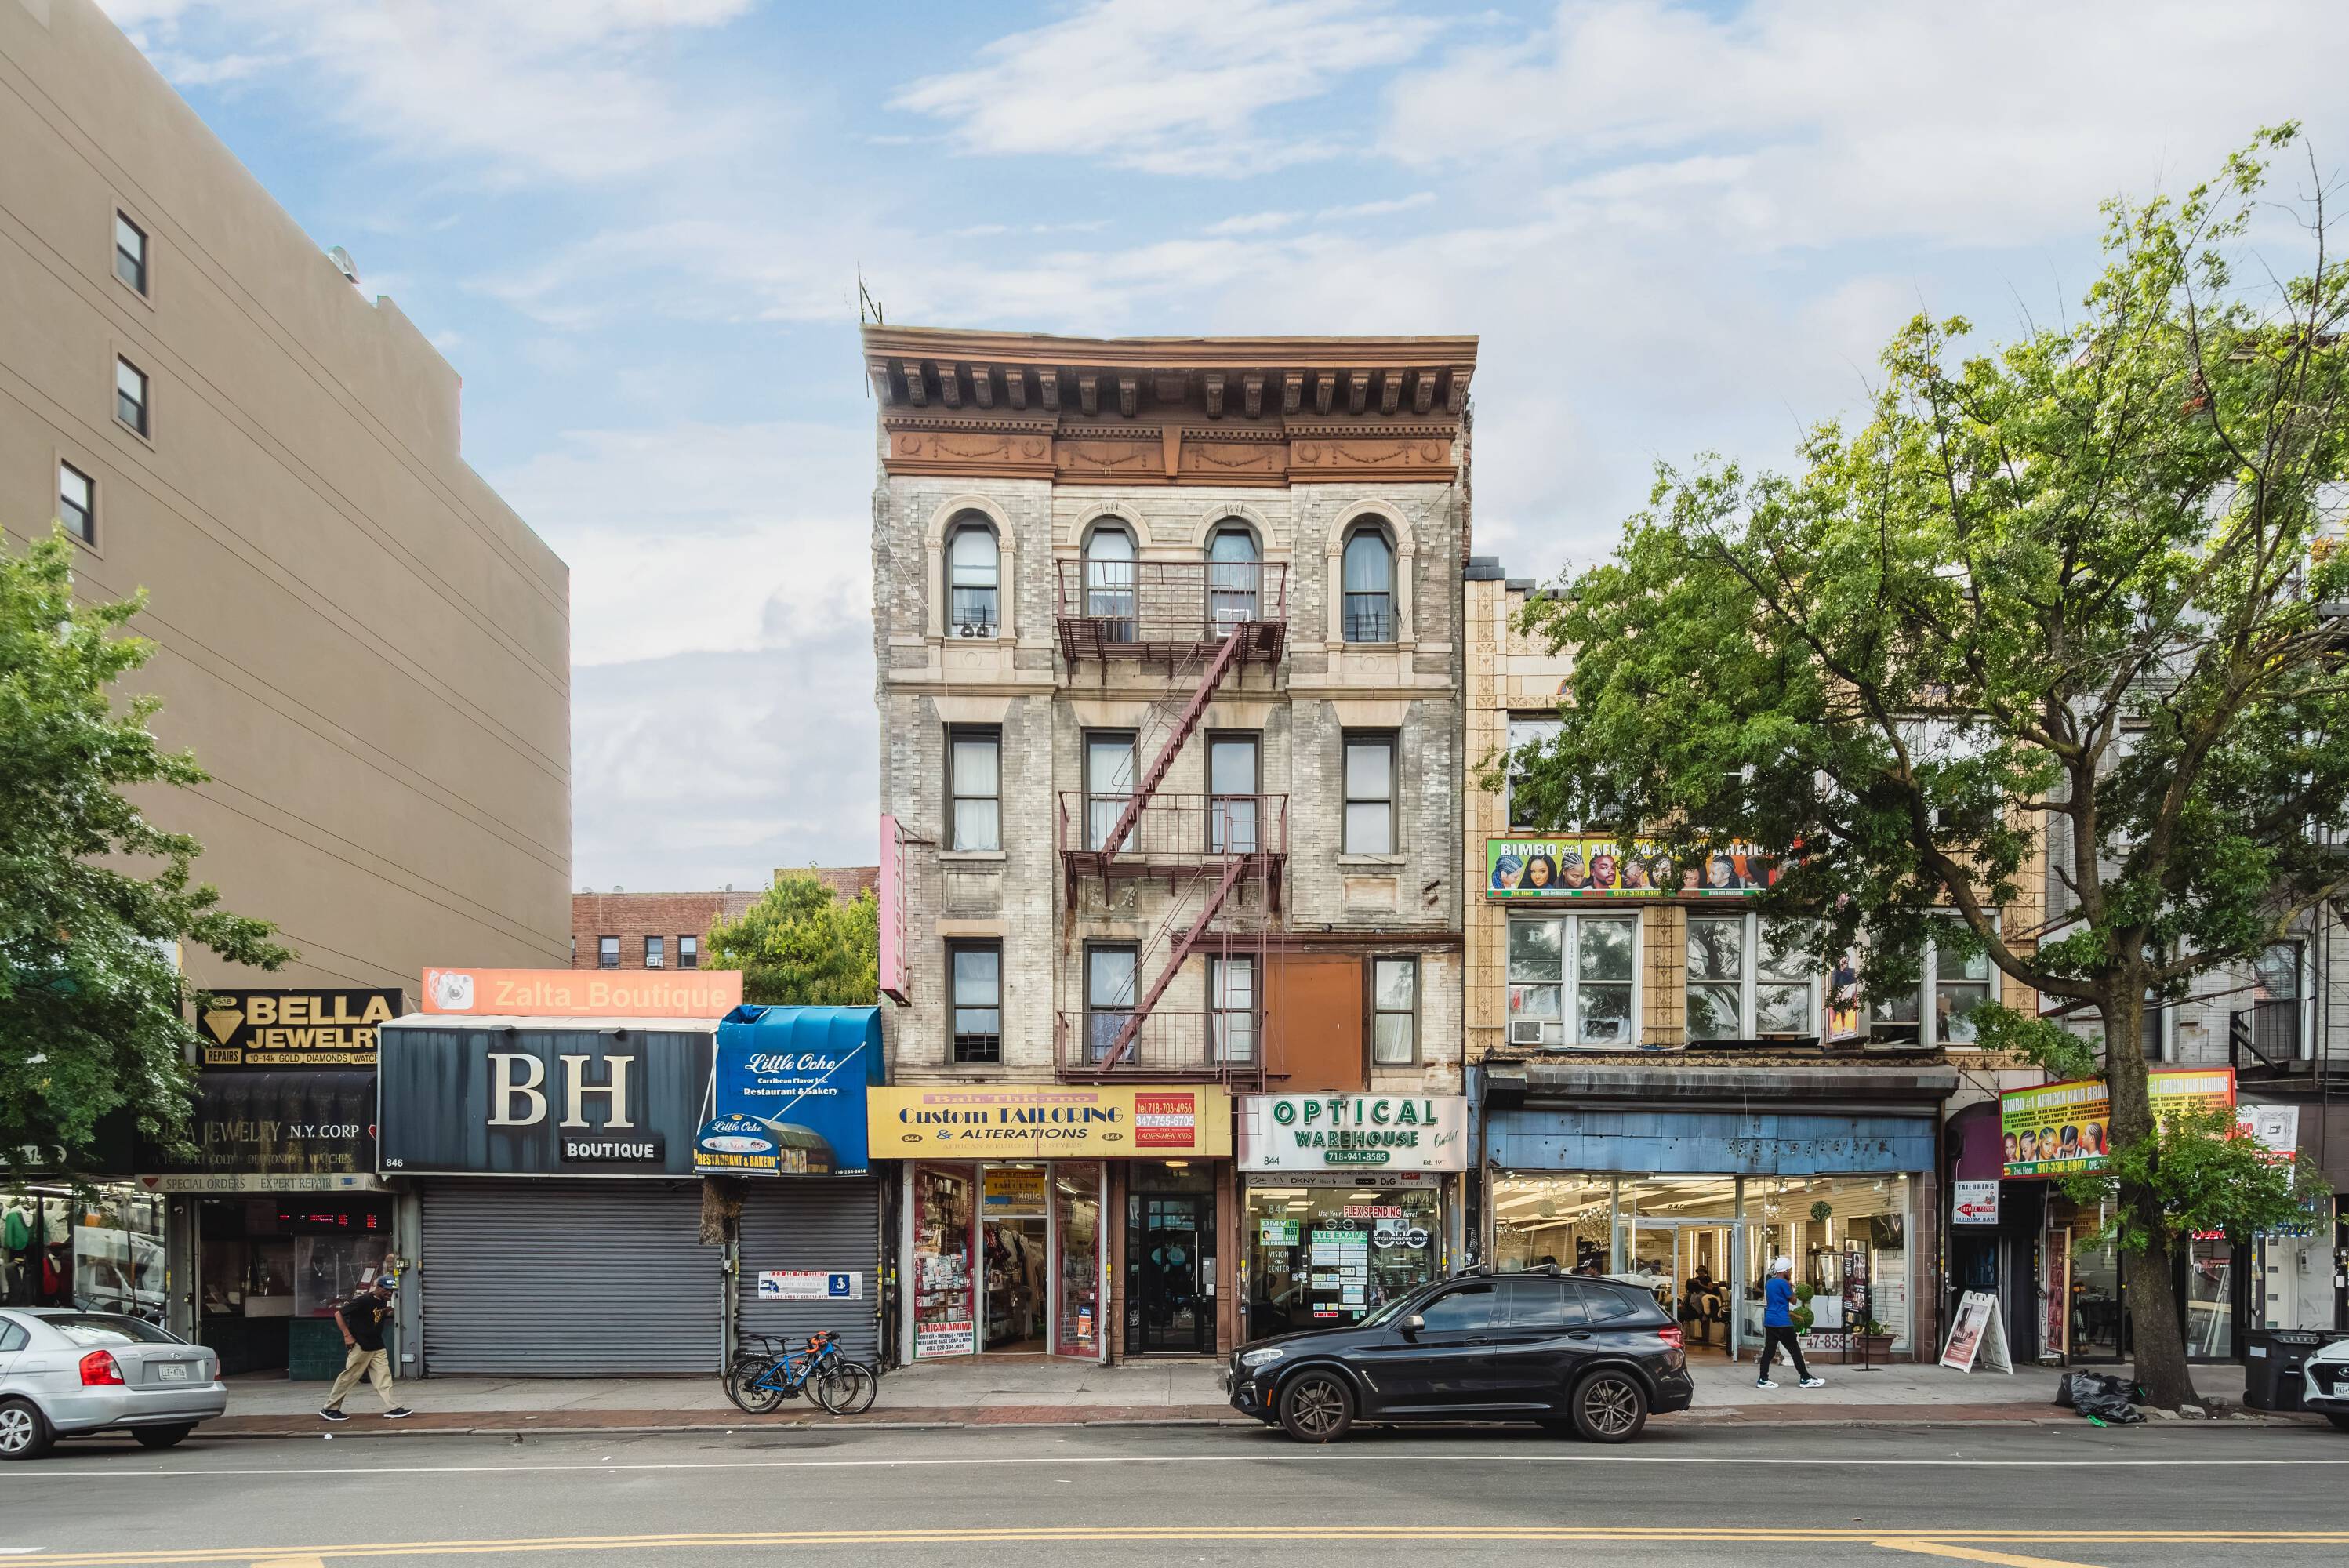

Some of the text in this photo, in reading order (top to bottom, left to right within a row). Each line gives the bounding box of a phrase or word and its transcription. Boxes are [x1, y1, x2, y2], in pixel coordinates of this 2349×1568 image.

[1501, 844, 1582, 856] BIMBO #1
[496, 980, 728, 1016] Zalta_Boutique
[247, 996, 394, 1025] BELLA
[208, 1051, 238, 1062] REPAIRS
[279, 1054, 300, 1062] GOLD
[307, 1054, 347, 1062] DIAMONDS
[744, 1053, 836, 1074] Little Oche
[487, 1053, 634, 1127] BH
[2159, 1079, 2184, 1094] AFRICAN
[2184, 1078, 2199, 1093] HAIR
[2200, 1076, 2227, 1092] BRAIDING
[806, 1087, 838, 1096] Bakery
[986, 1094, 1091, 1103] Thierno
[2002, 1097, 2024, 1113] BIMBO
[2025, 1094, 2035, 1110] #1
[2037, 1091, 2067, 1108] AFRICAN
[2068, 1087, 2086, 1104] HAIR
[899, 1106, 1124, 1123] Custom TAILORING
[1273, 1099, 1438, 1125] OPTICAL
[712, 1120, 763, 1132] Little Oche
[1136, 1116, 1194, 1127] 347-755-6705
[202, 1120, 281, 1147] JEWELRY
[290, 1125, 315, 1138] N.Y.
[320, 1125, 359, 1138] CORP
[936, 1128, 1087, 1139] & ALTERATIONS
[1294, 1130, 1419, 1147] WAREHOUSE
[1434, 1129, 1459, 1149] Outlet
[567, 1142, 654, 1159] BOUTIQUE
[386, 1159, 403, 1167] 846
[697, 1156, 776, 1168] RESTAURANT & BAKERY
[1264, 1156, 1280, 1165] 844
[1328, 1152, 1386, 1162] 718-941-8585
[166, 1178, 332, 1189] SPECIAL ORDERS EXPERT REPAIR
[1268, 1205, 1287, 1214] 844
[1344, 1206, 1363, 1217] FLEX
[1364, 1206, 1401, 1218] SPENDING
[2192, 1228, 2225, 1240] OPEN
[917, 1322, 972, 1333] AFRICAN AROMA
